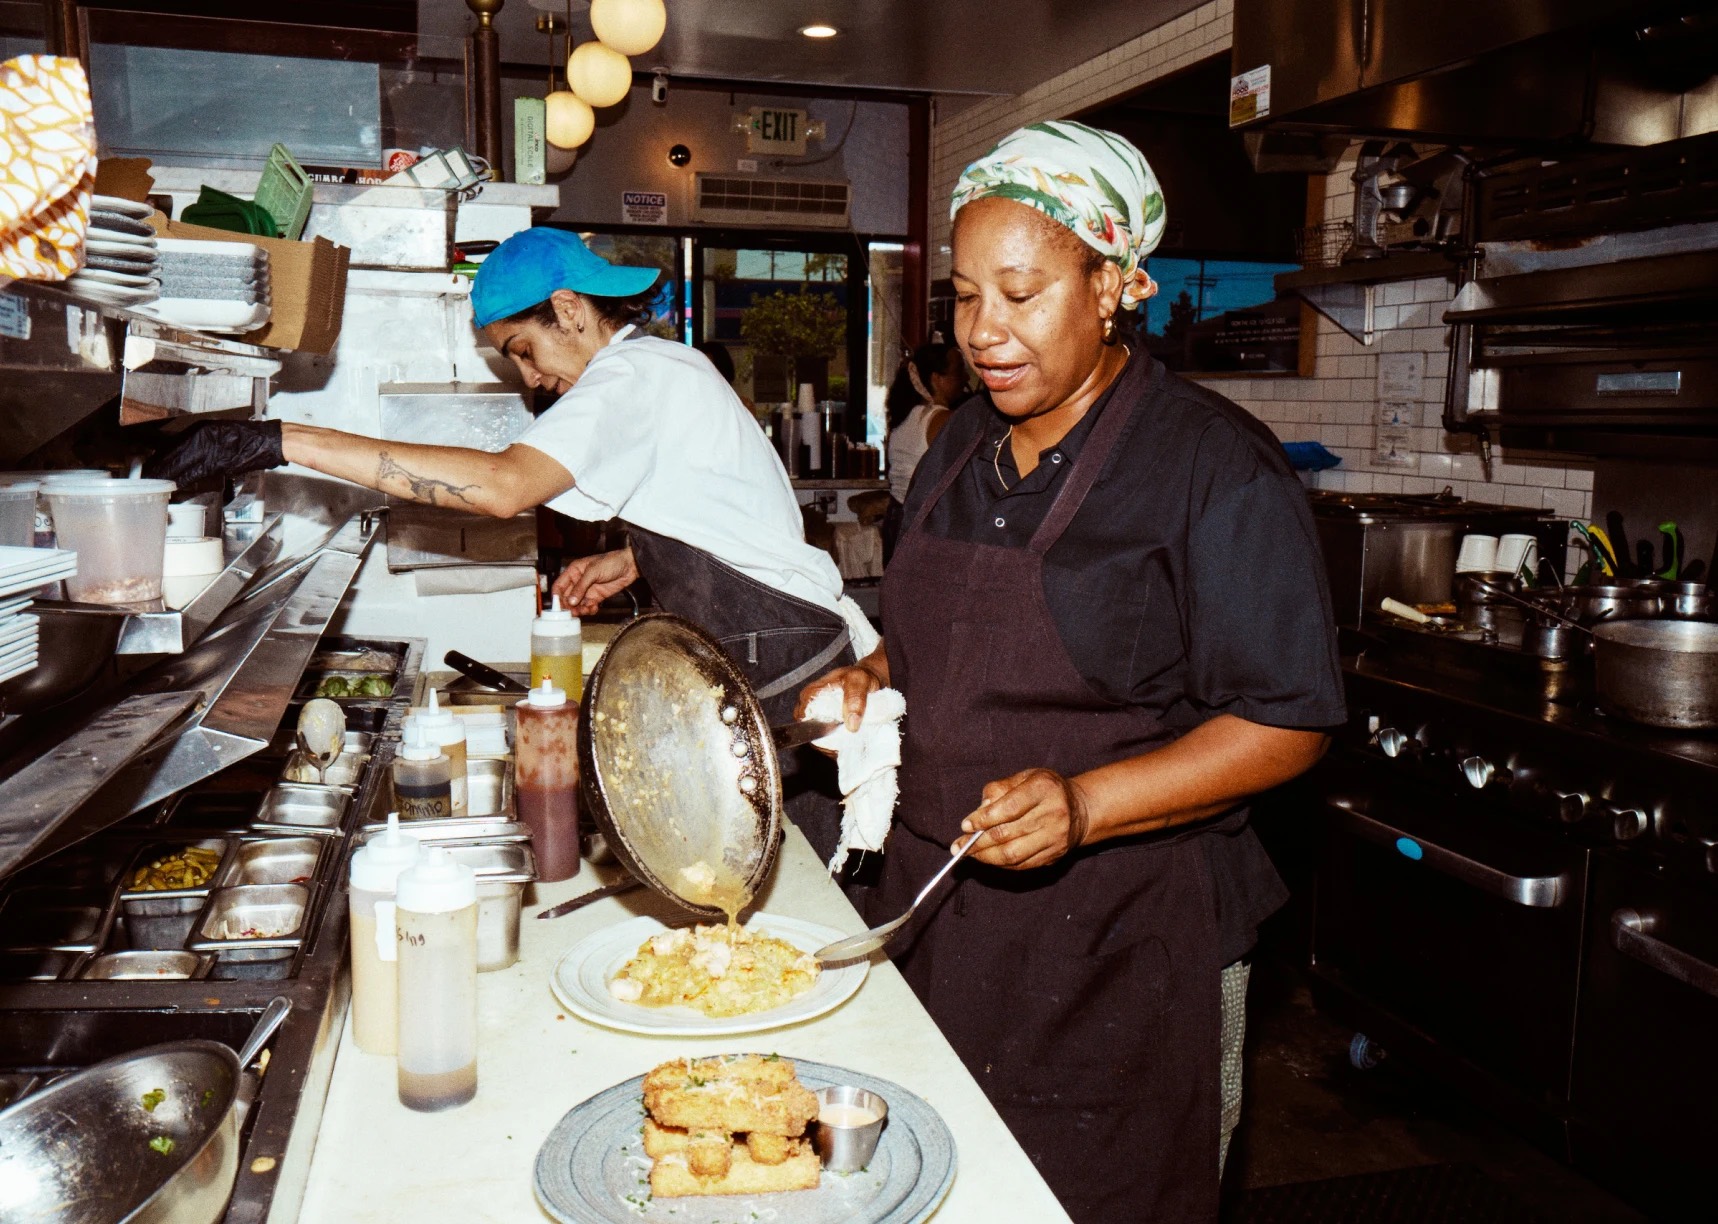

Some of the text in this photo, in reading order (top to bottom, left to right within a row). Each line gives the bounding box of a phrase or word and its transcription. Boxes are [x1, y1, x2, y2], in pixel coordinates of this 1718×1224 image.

[762, 111, 798, 141] EXIT
[356, 176, 383, 185] HOP
[625, 194, 664, 205] NOTICE
